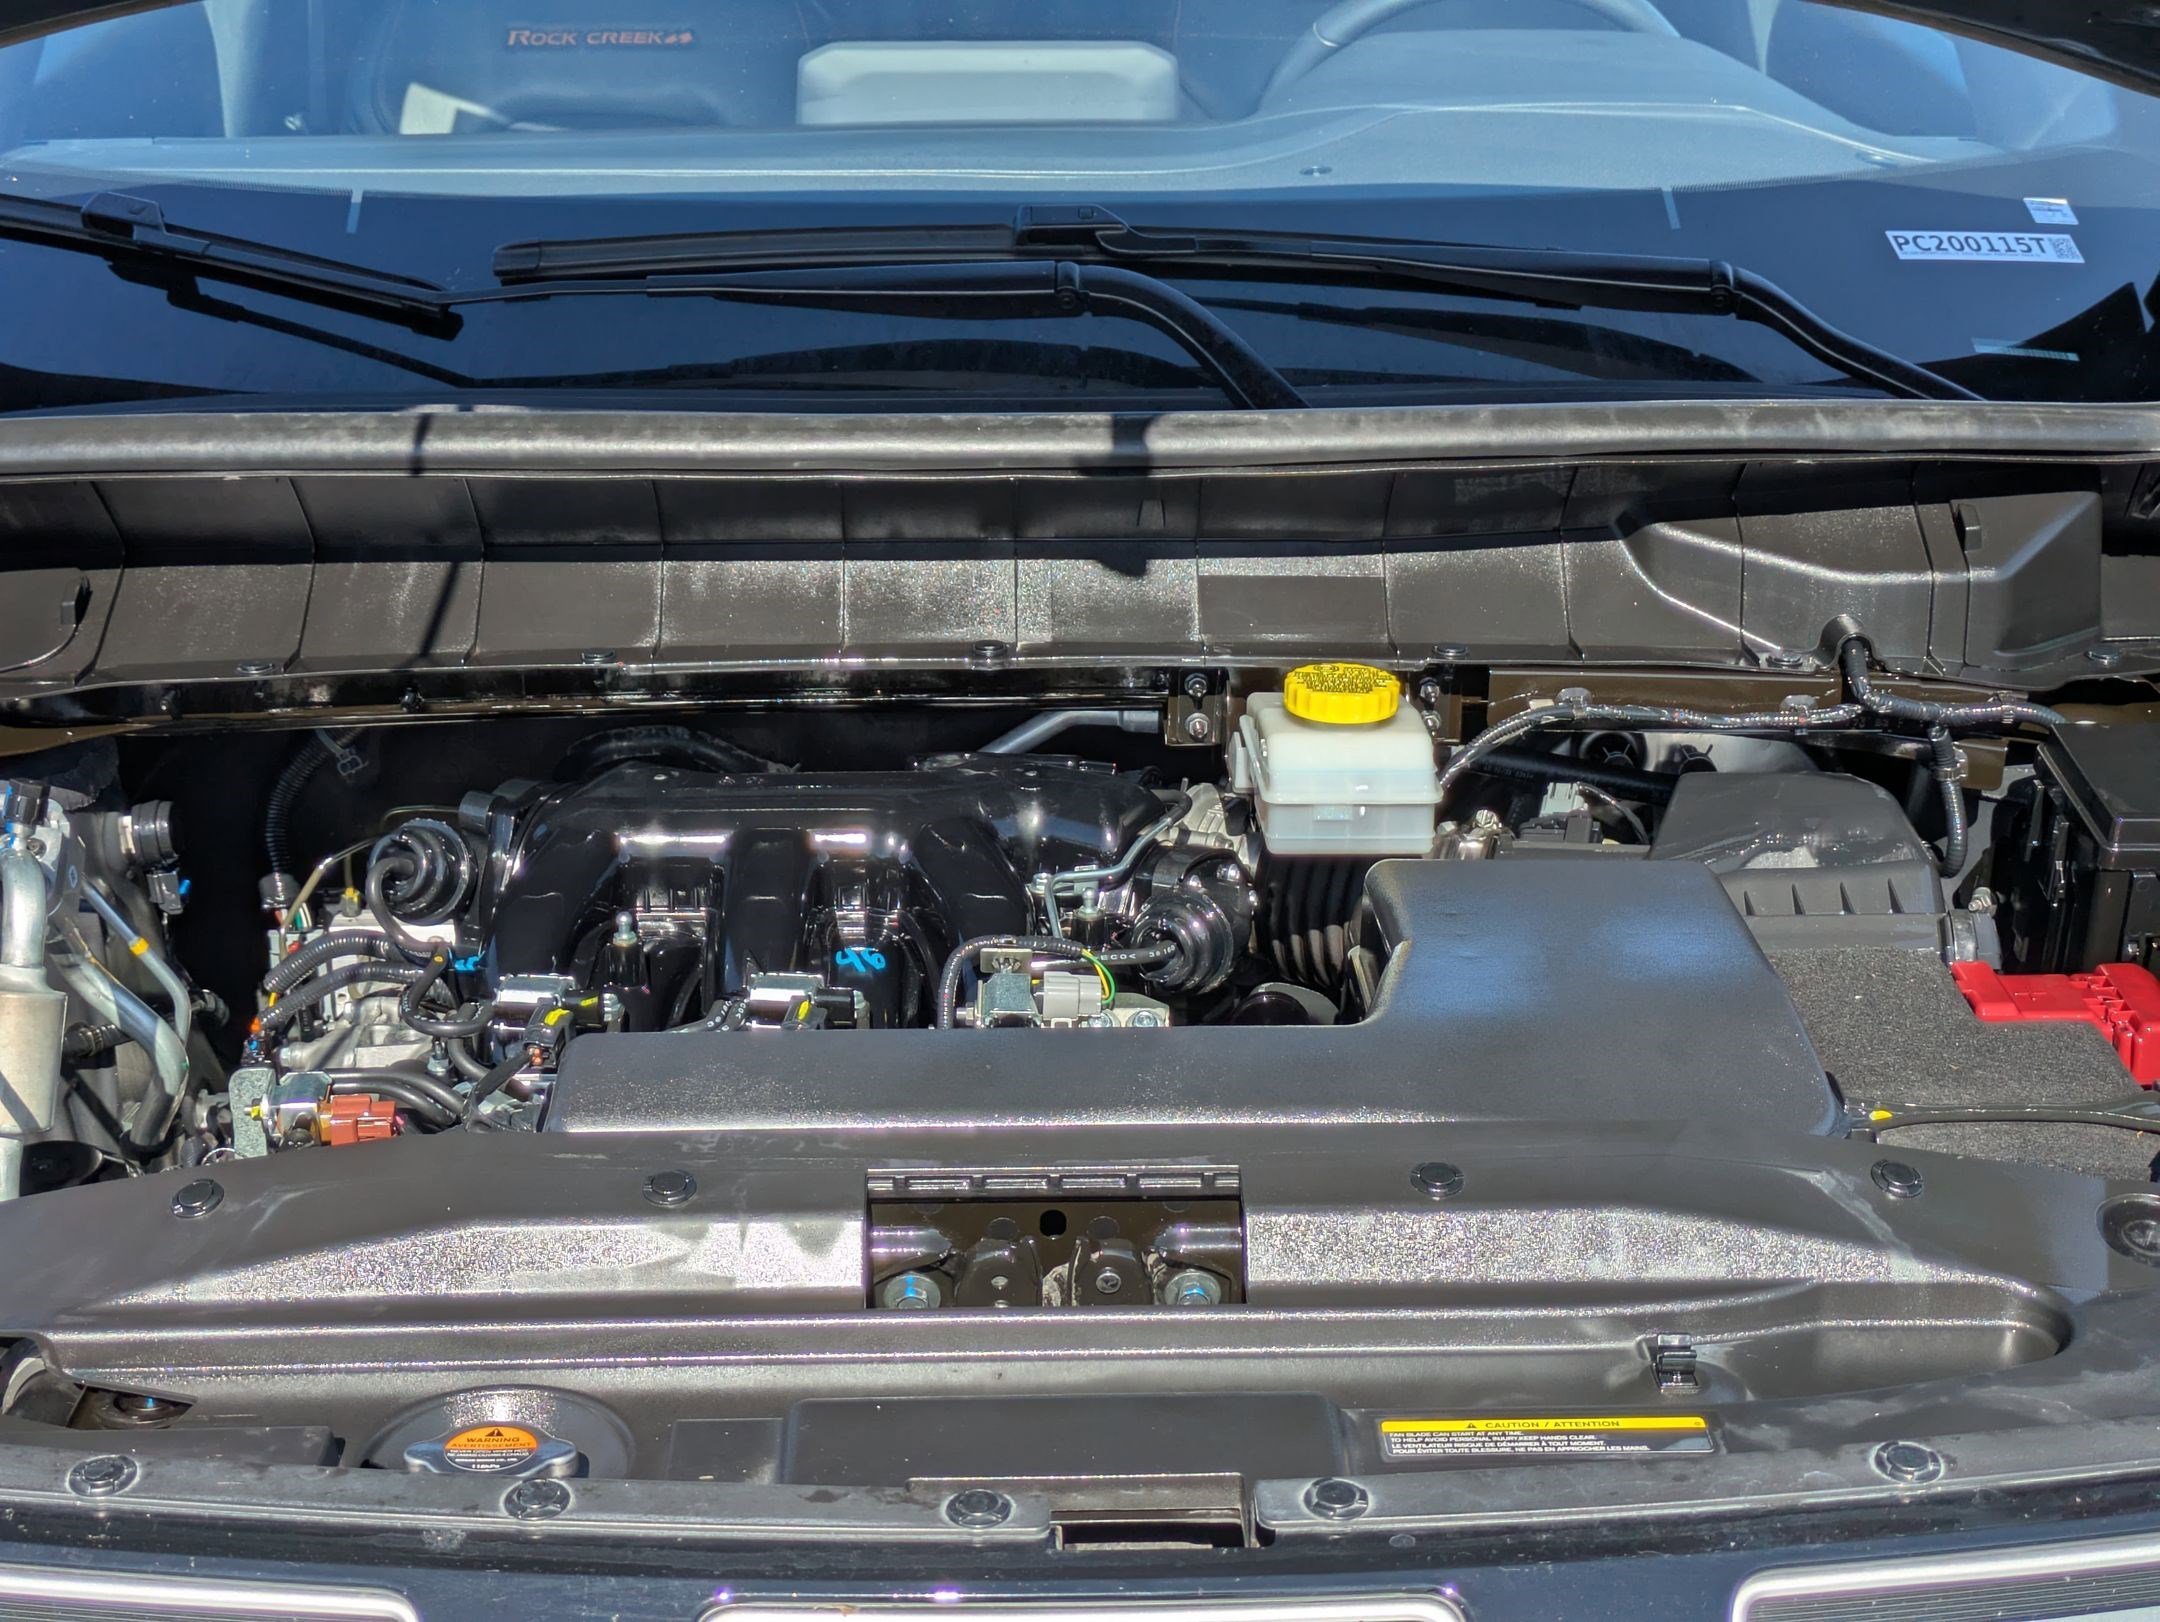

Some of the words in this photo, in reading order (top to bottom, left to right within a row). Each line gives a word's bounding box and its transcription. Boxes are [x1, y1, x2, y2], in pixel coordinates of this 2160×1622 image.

[507, 29, 578, 46] ROCK
[586, 30, 664, 45] CREEK
[1892, 234, 2046, 254] PC200115T
[1485, 1421, 1540, 1429] CAUTION
[1554, 1420, 1620, 1428] ATTENTION
